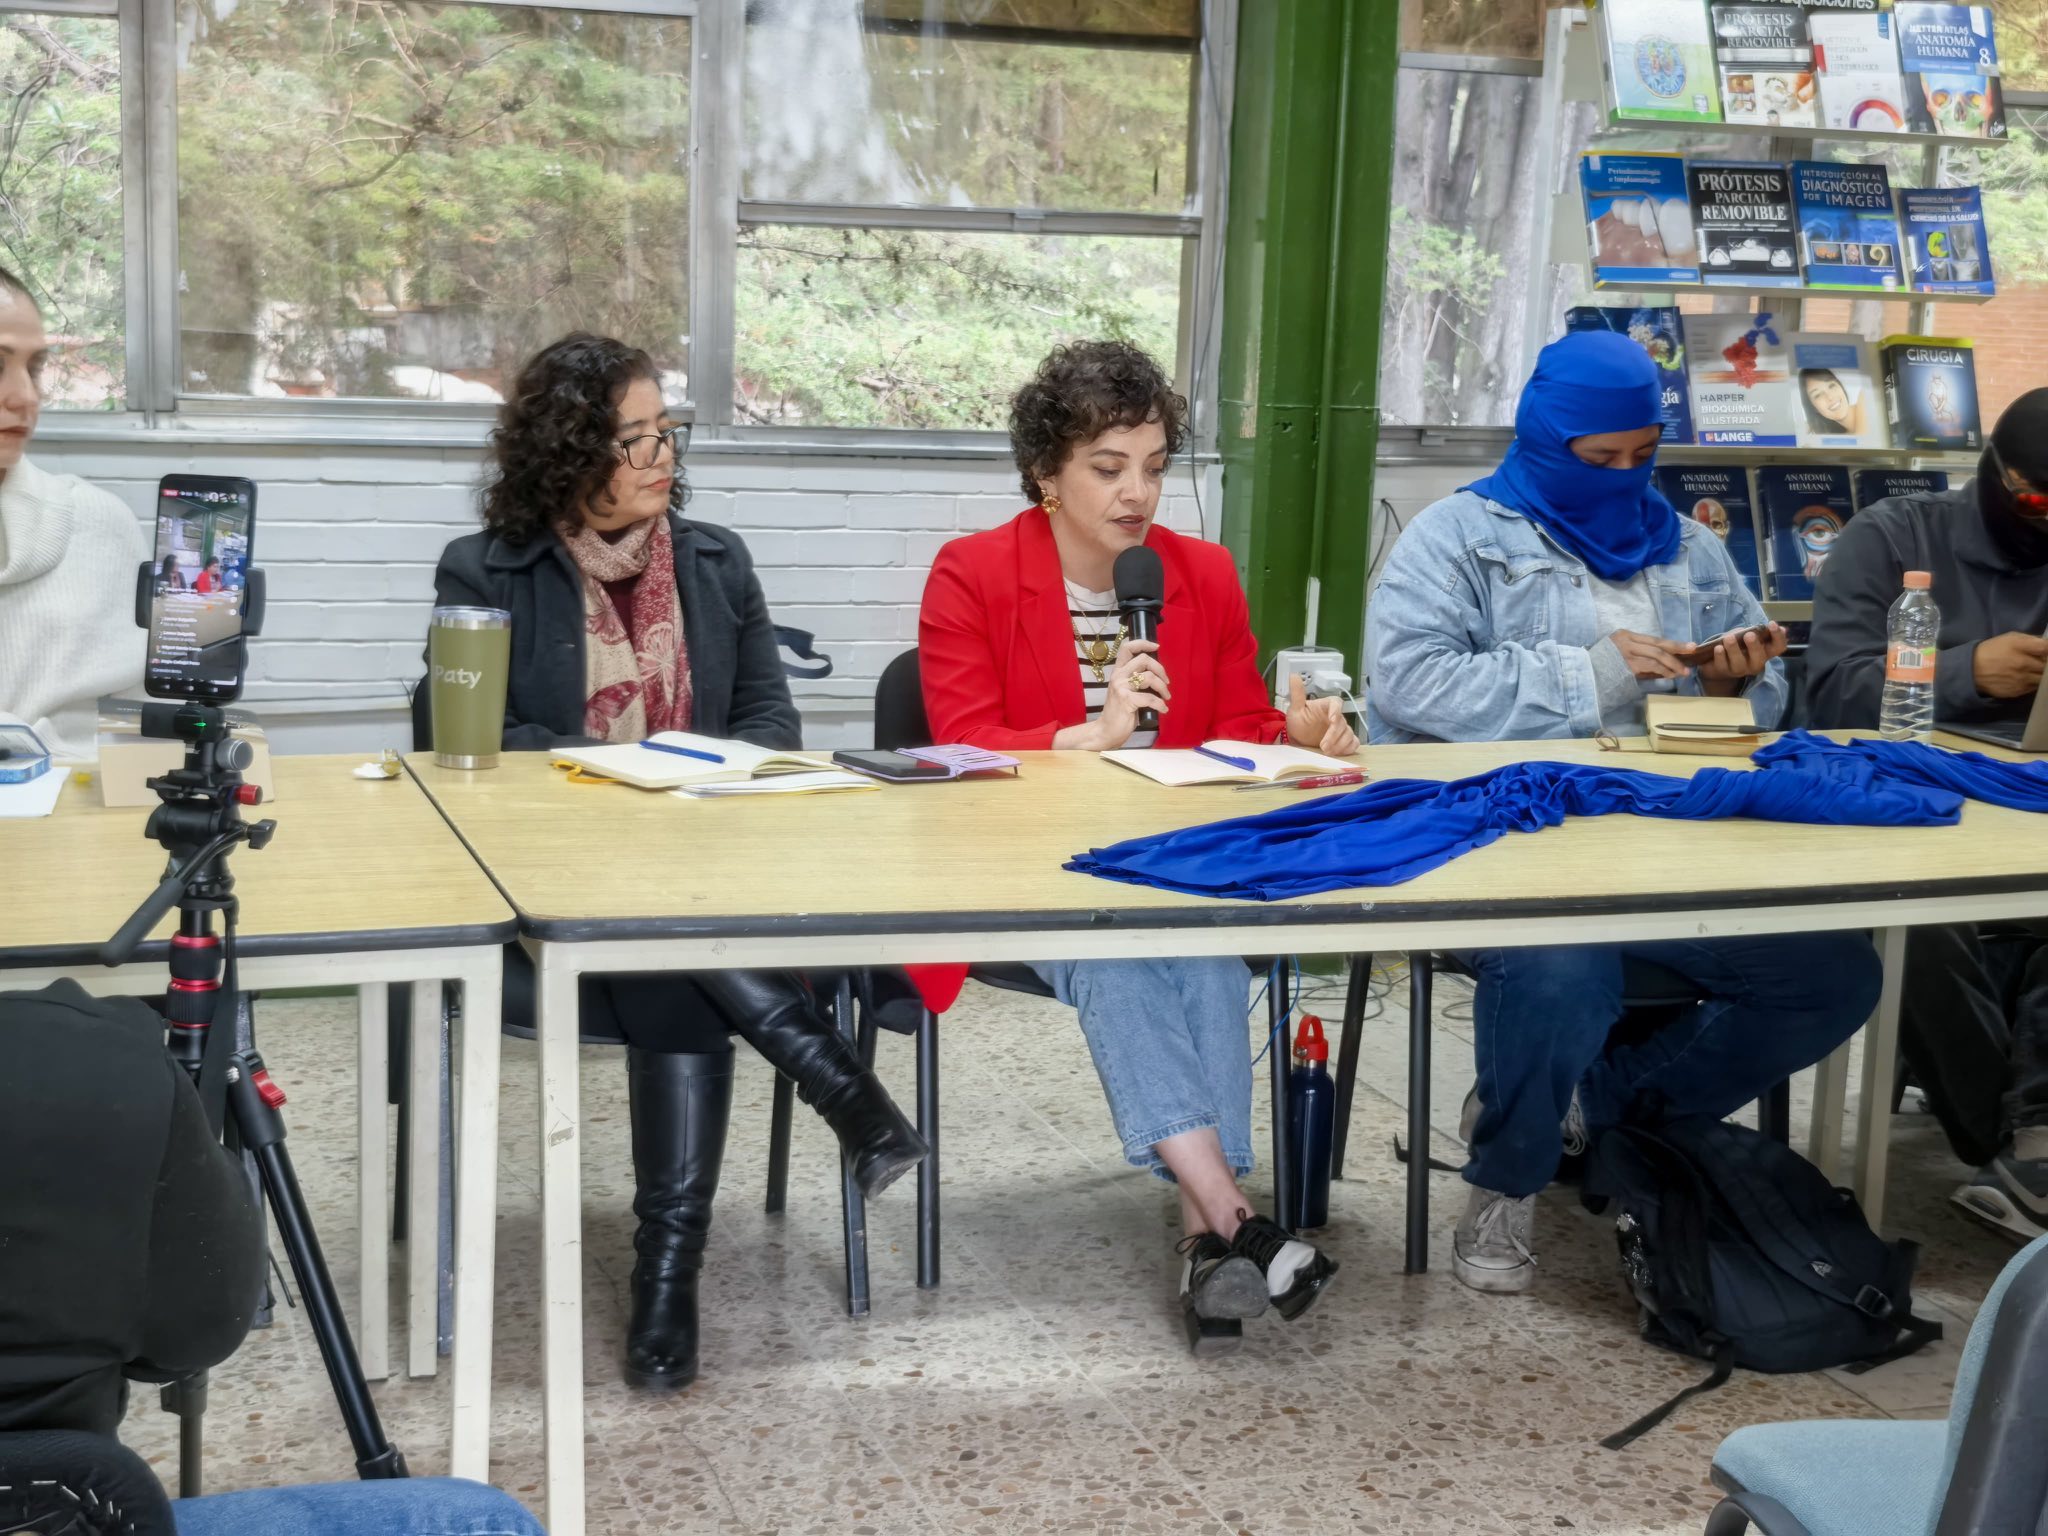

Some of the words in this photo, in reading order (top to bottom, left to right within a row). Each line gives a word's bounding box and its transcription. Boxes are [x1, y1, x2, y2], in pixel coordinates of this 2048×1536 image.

[1731, 26, 1790, 37] ARCIAL
[1727, 37, 1797, 48] REMOVIBLE
[1916, 46, 1969, 58] HUMANA
[1978, 48, 1991, 66] 8
[1698, 170, 1782, 192] PRÓTESIS
[1801, 179, 1883, 195] DIAGNÓSTICO
[1715, 192, 1770, 204] PARCIAL
[1825, 194, 1886, 208] IMAGEN
[1701, 205, 1788, 220] REMOVIBLE
[1700, 393, 1745, 402] HARPER
[1702, 416, 1761, 425] ILUSTRADA
[1713, 432, 1753, 442] LANGE
[1684, 482, 1729, 492] HUMANA
[1788, 482, 1831, 491] HUMANA
[435, 664, 482, 689] Paty
